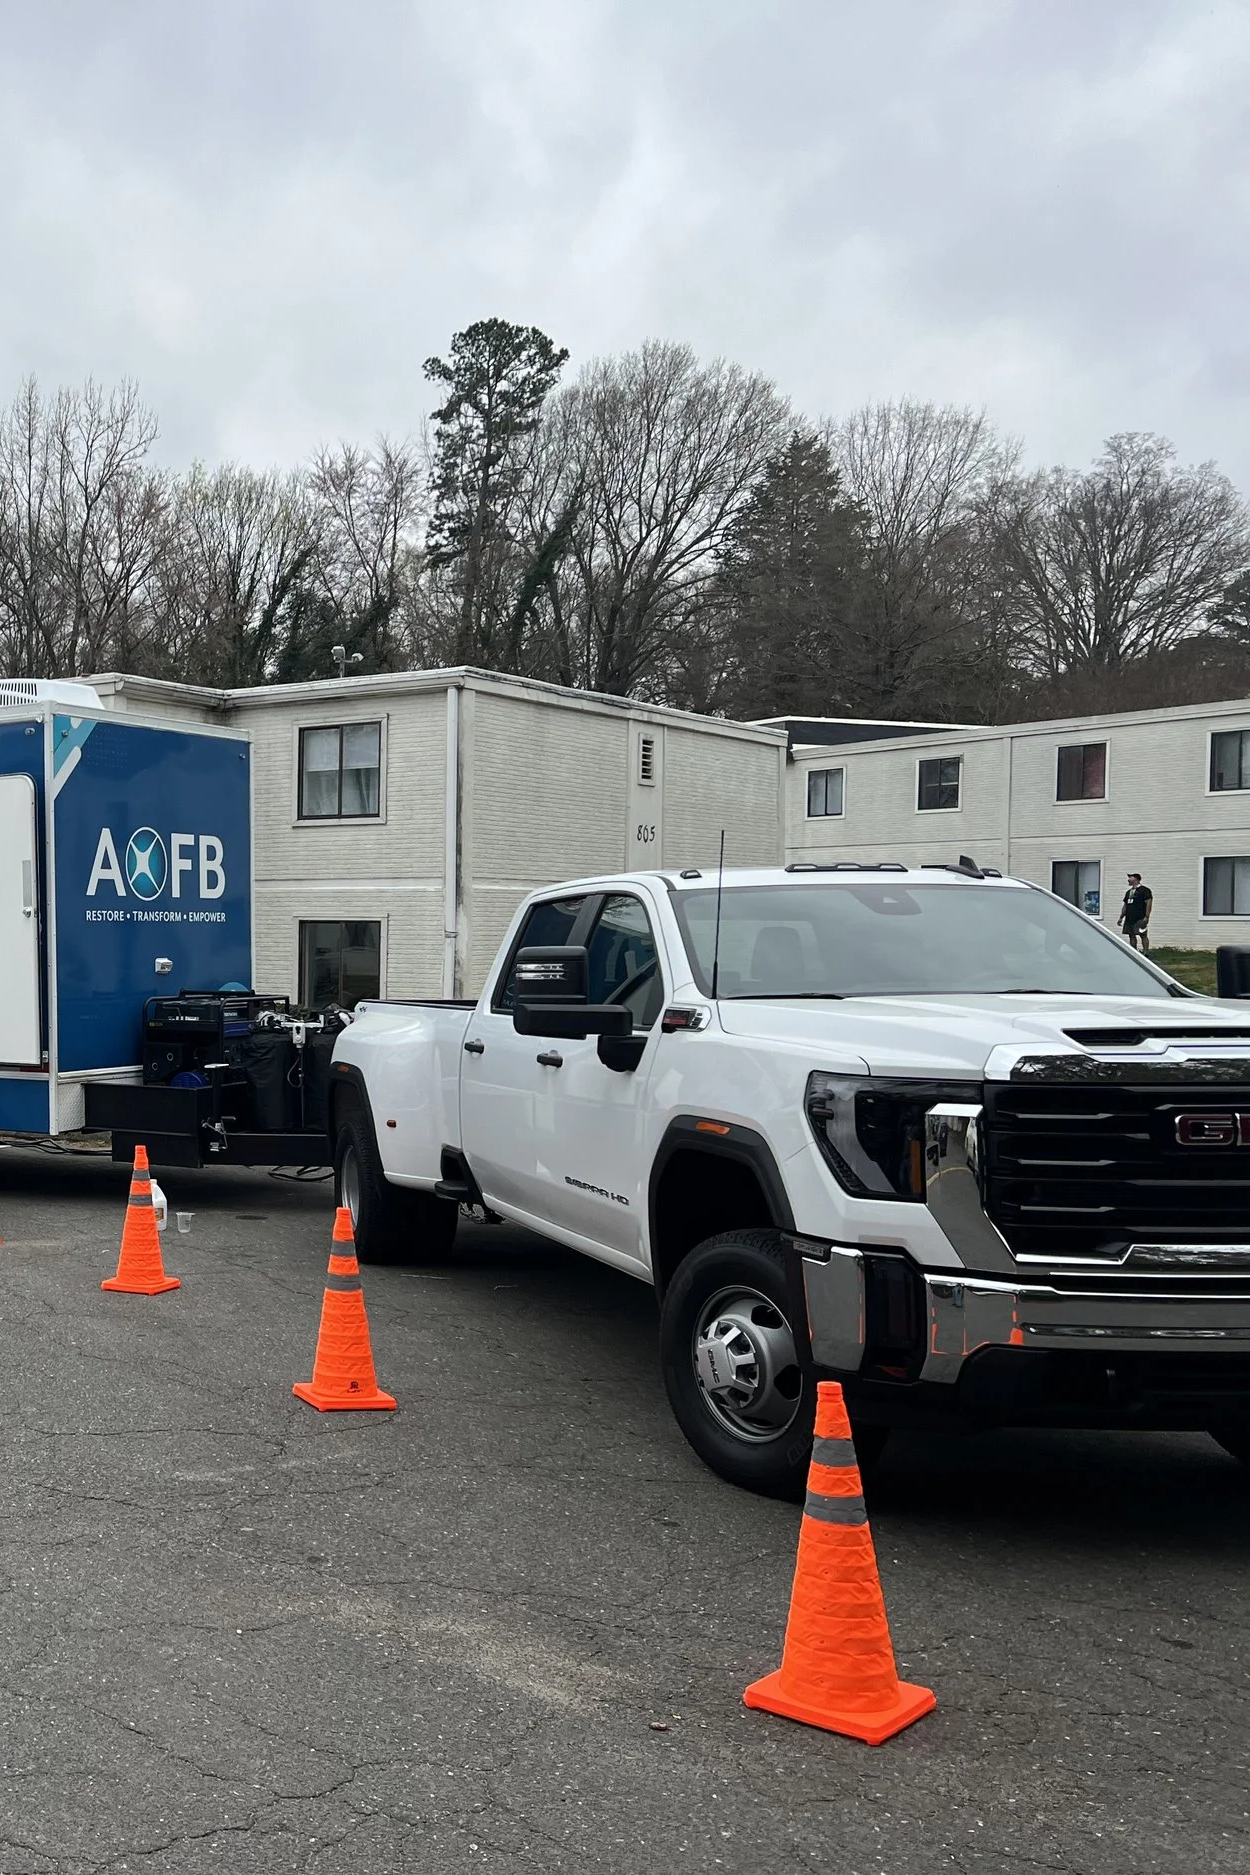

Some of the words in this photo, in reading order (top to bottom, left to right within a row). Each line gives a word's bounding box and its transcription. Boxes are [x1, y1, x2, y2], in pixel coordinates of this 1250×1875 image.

[85, 910, 125, 922] RESTORE
[132, 910, 182, 922] TRANSFORM
[188, 911, 227, 922] EMPOWER
[565, 1176, 609, 1198] SIERRA
[611, 1192, 630, 1206] HD
[707, 1348, 721, 1384] GMC
